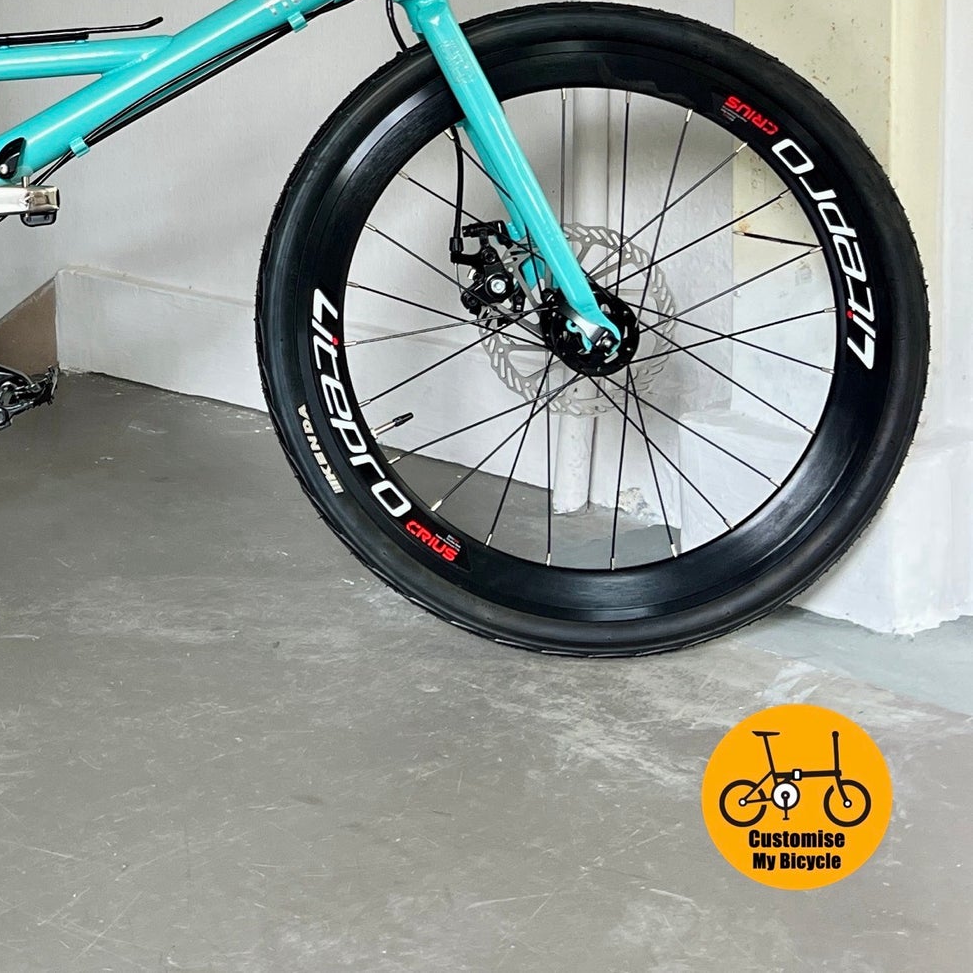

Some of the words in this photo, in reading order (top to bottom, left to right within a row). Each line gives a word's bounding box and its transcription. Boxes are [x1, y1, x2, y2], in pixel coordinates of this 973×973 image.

[724, 95, 779, 136] CRIUS
[297, 404, 342, 492] KENDA
[405, 520, 459, 562] CRIUS
